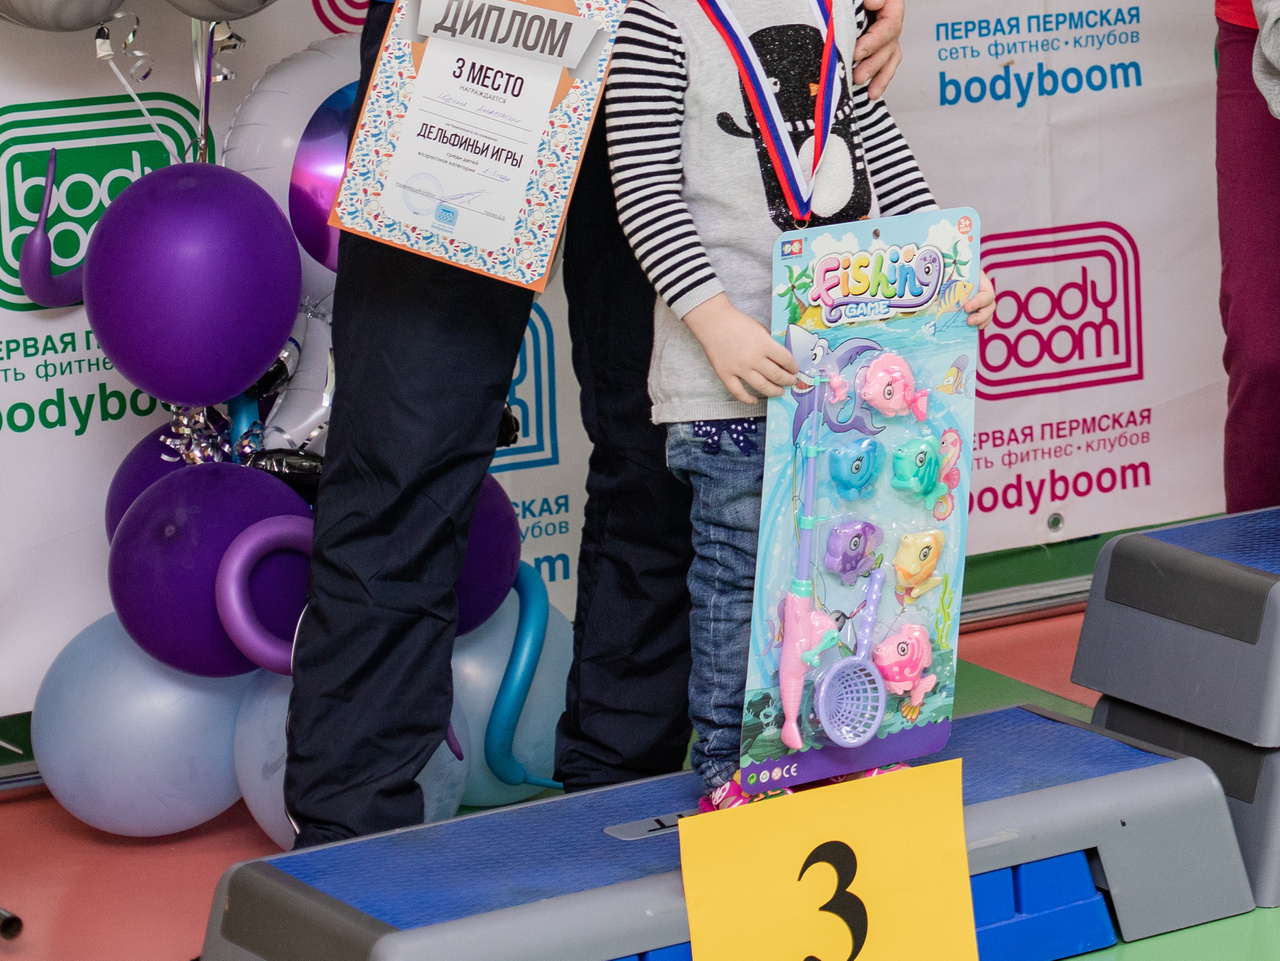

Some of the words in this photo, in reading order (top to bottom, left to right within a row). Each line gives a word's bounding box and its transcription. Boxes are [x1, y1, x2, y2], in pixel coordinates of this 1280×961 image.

[936, 17, 1020, 41] ПЕРВАЯ
[1027, 6, 1140, 34] ПЕРМСКАЯ
[938, 44, 980, 61] сеть
[453, 57, 465, 79] 3
[467, 62, 524, 98] МЕСТО
[460, 85, 506, 104] НАГРАЖДАЕТСЯ
[939, 61, 1142, 108] bodyboom
[417, 123, 490, 157] ДЕЛЬФИНЬИ
[490, 145, 523, 168] ИГРЫ
[13, 150, 153, 222] bod
[960, 219, 970, 227] 3+
[811, 245, 942, 307] Fishing
[845, 299, 891, 318] GAME
[979, 319, 1119, 372] boom
[1041, 408, 1152, 440] ПЕРМСКАЯ
[969, 461, 1151, 515] odyboom
[797, 840, 868, 961] 3
